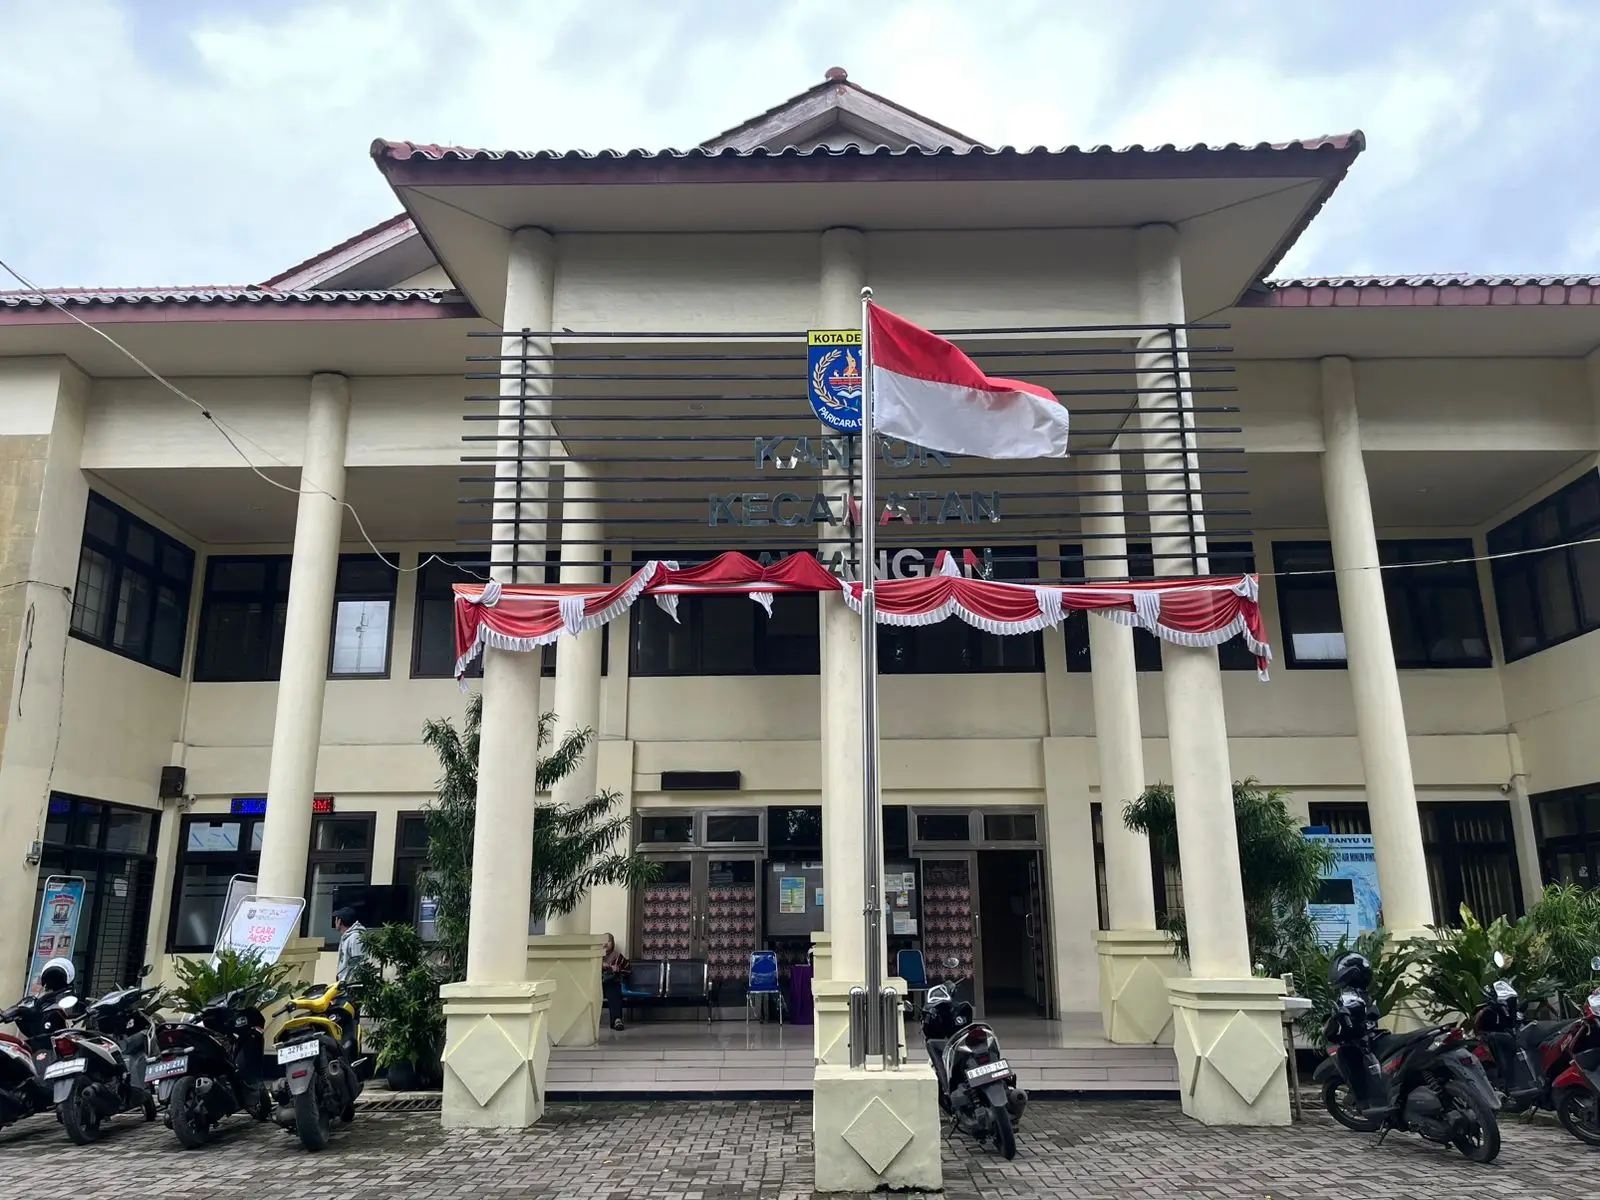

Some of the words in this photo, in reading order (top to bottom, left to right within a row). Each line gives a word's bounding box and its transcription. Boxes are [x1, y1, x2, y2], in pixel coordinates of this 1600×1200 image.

[814, 334, 844, 343] KOTA
[847, 334, 863, 343] DE
[818, 406, 857, 428] PARICARA
[755, 437, 951, 469] KANOR
[256, 925, 276, 935] CARA
[248, 934, 272, 944] AKSES
